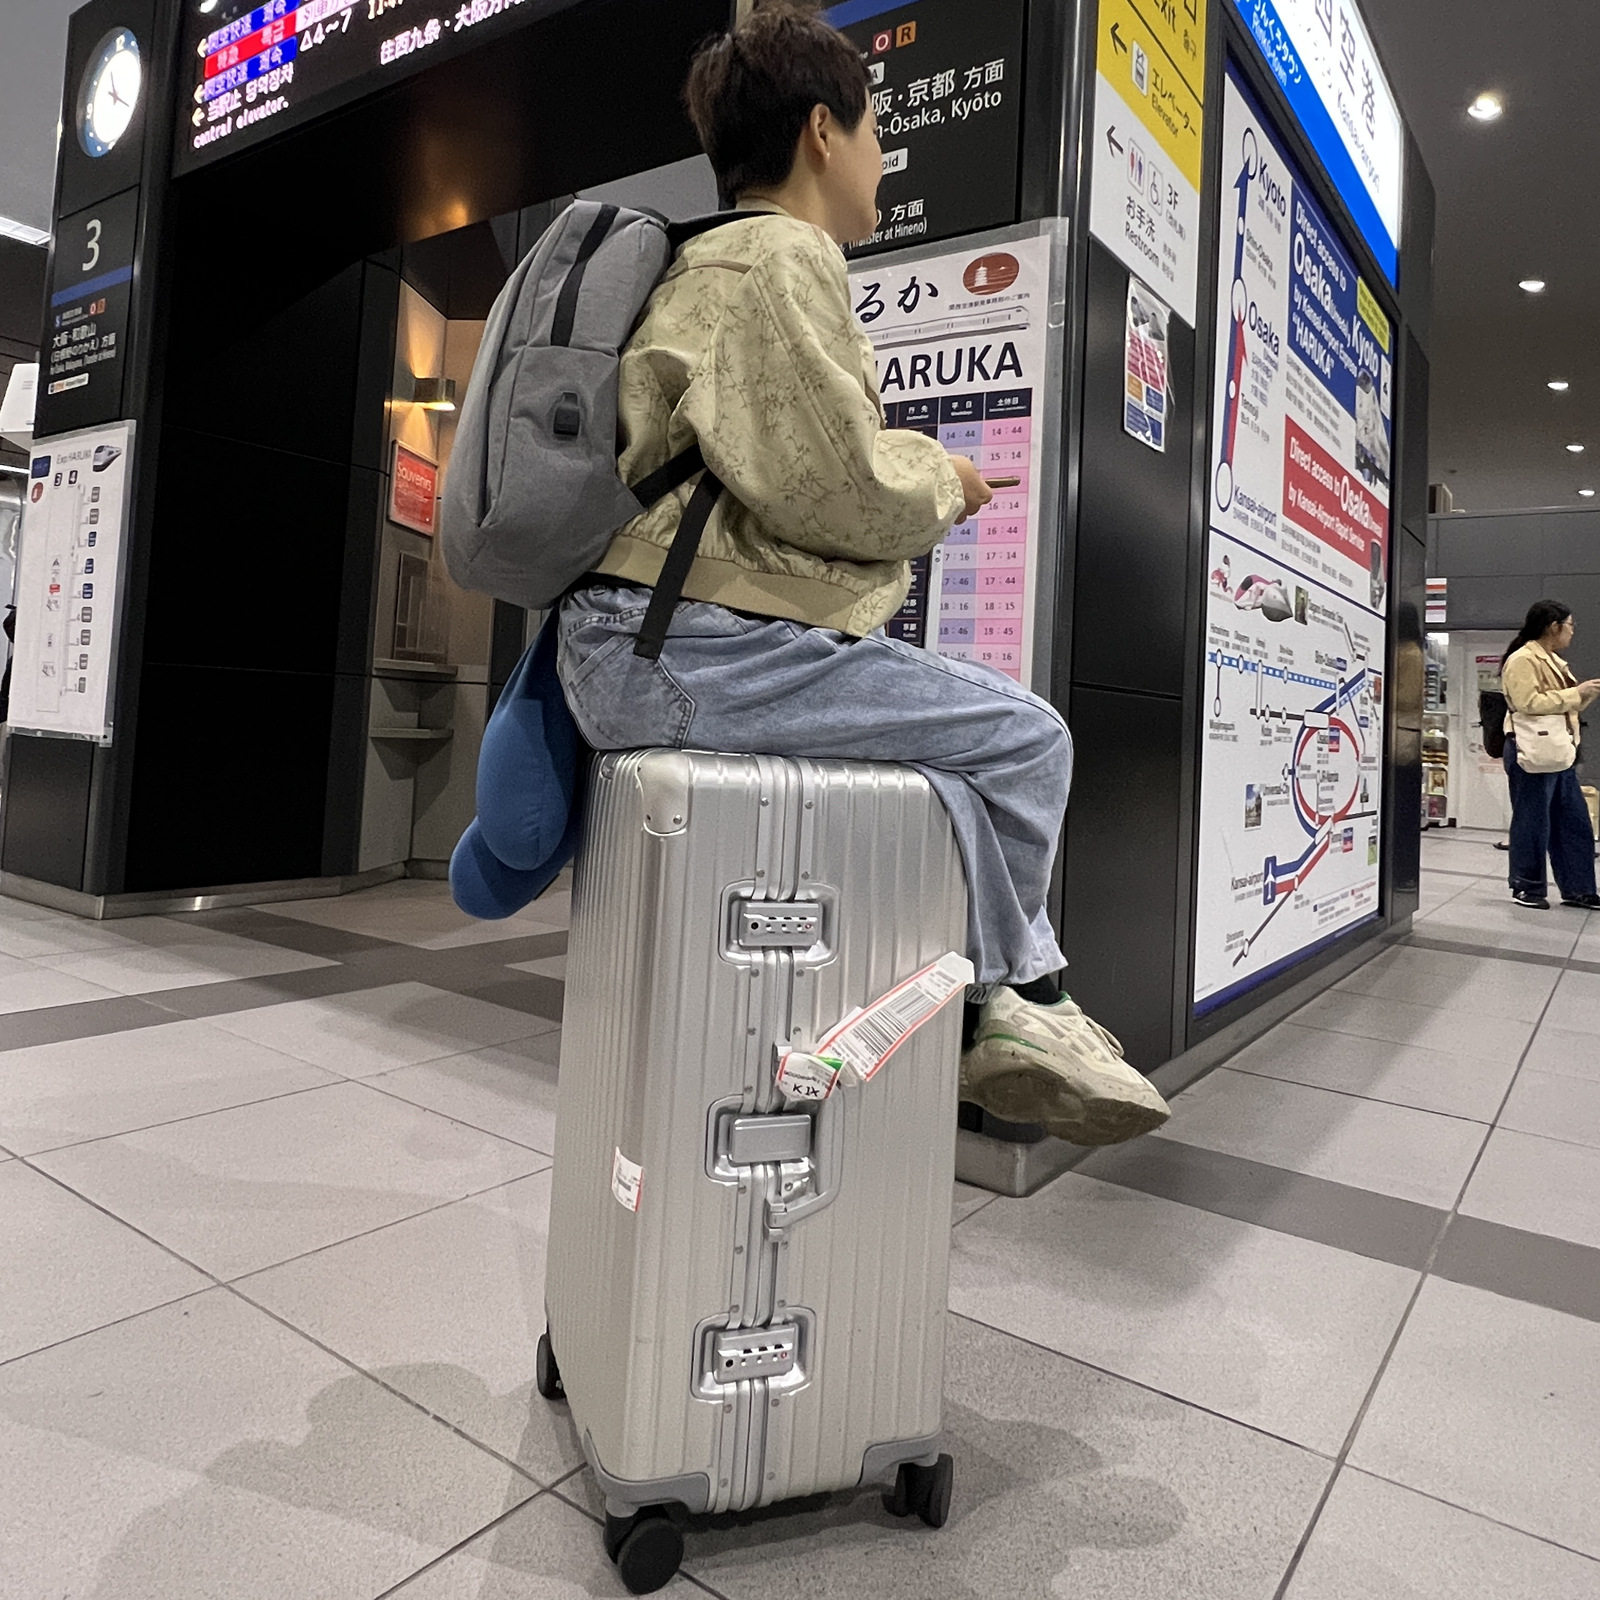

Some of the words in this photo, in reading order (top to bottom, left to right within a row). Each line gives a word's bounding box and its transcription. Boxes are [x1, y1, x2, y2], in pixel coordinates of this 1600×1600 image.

[963, 58, 1005, 92] 方面
[890, 198, 925, 223] 方面
[1258, 156, 1287, 217] Kyoto
[81, 218, 102, 272] 3
[1125, 220, 1160, 268] Restroom
[1296, 200, 1318, 249] Direct
[1248, 300, 1280, 357] Osaka
[1352, 314, 1379, 378] Kyoto
[875, 341, 1024, 395] ARUKA
[398, 461, 432, 492] Souvenirs
[1290, 436, 1312, 474] Direct
